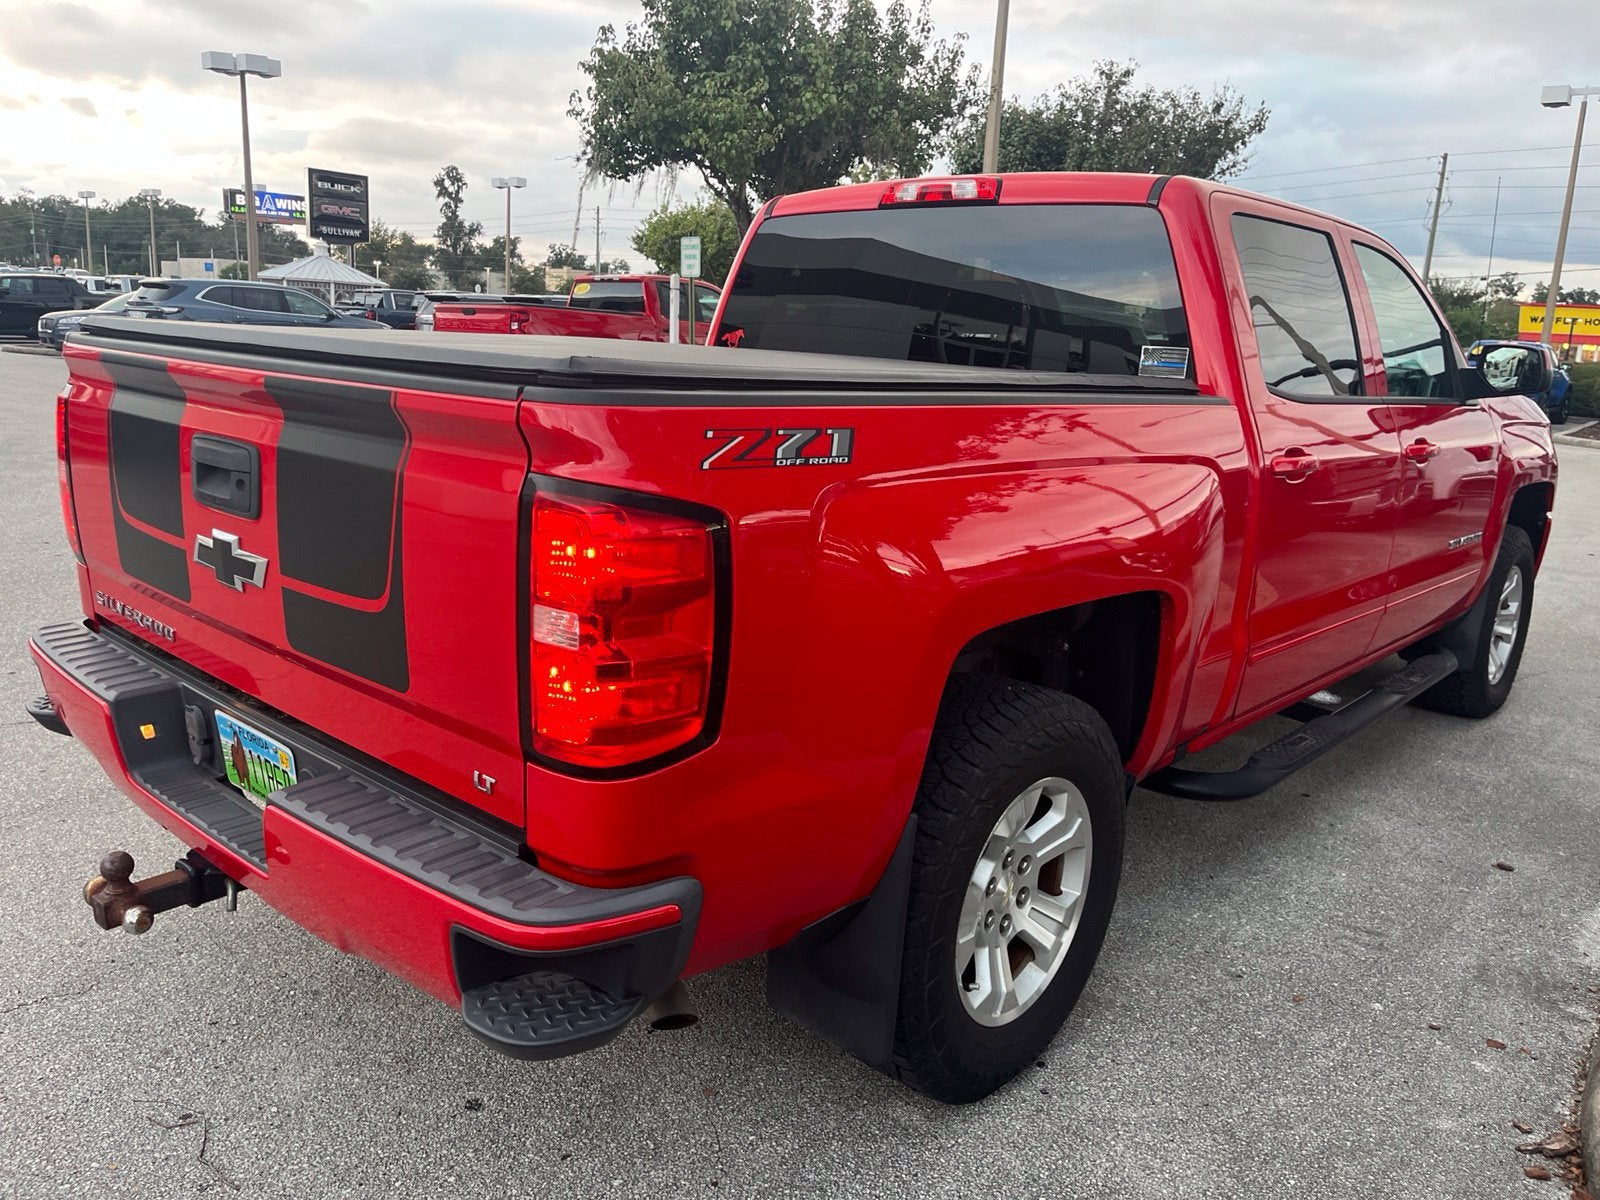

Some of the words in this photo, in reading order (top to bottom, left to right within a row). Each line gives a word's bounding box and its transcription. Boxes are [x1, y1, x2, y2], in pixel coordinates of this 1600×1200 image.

[317, 181, 363, 193] BUICK
[235, 193, 260, 207] BG
[320, 204, 361, 217] GMC
[321, 225, 361, 238] SULLIVAN
[700, 428, 855, 471] Z71
[775, 458, 805, 467] OFF
[808, 456, 849, 465] ROAD
[96, 590, 177, 642] SILVERADO
[238, 726, 270, 751] FLORIDA
[473, 769, 496, 795] LT
